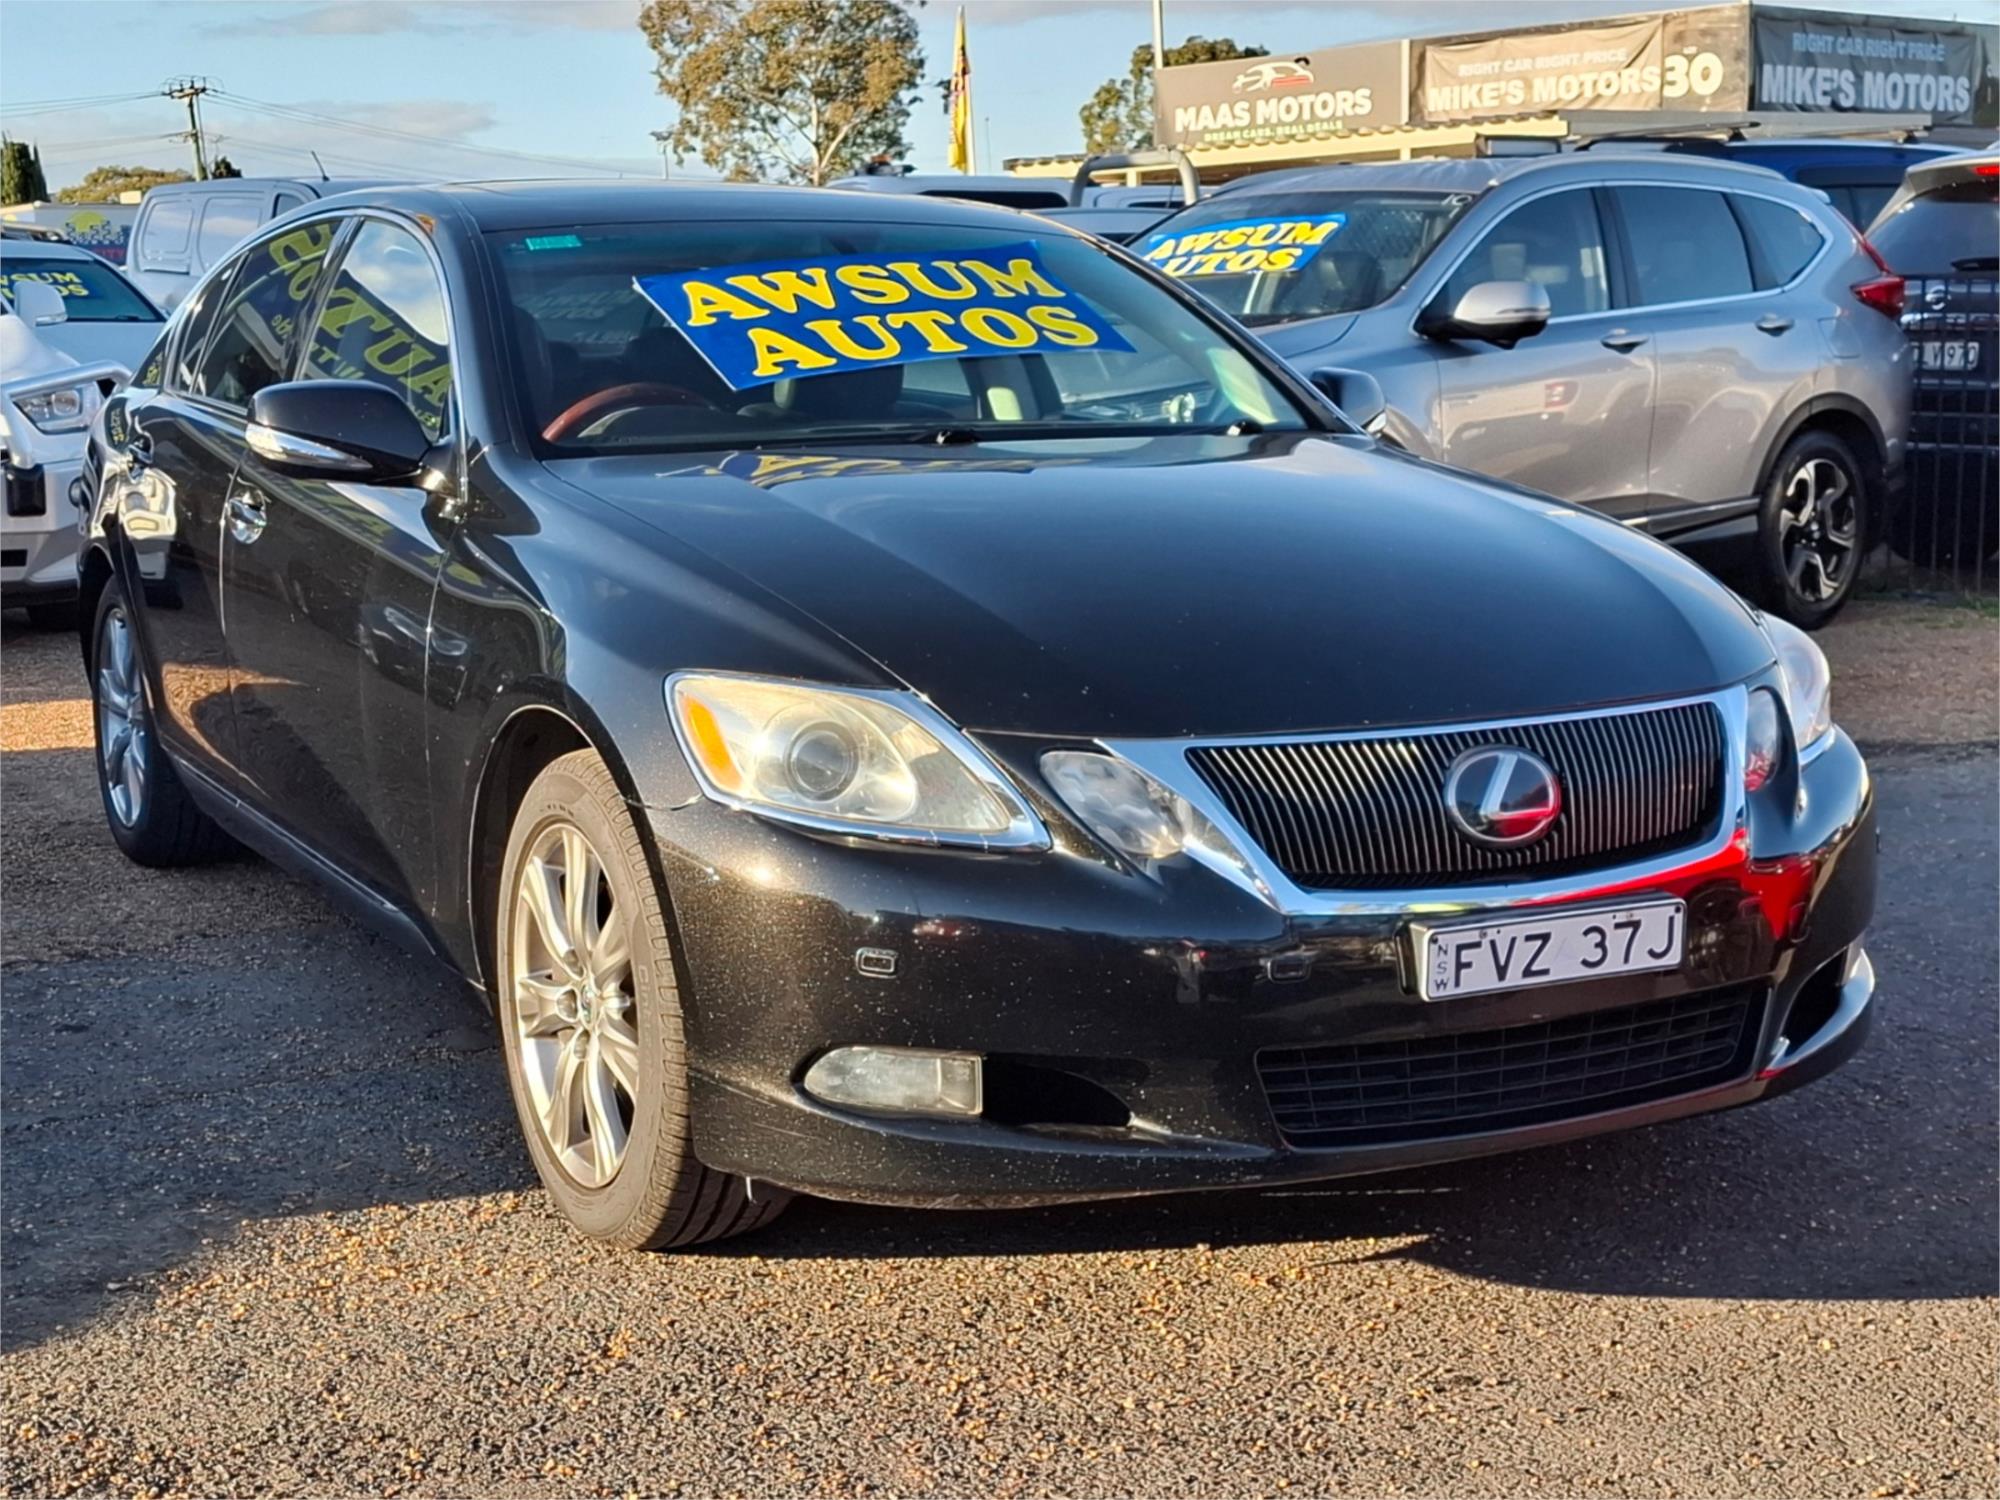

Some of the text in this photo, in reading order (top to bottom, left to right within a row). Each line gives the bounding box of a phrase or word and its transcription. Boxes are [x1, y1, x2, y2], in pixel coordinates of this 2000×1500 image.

[1458, 48, 1628, 77] RIGHT CAR RIGHT PRICE
[1792, 31, 1945, 62] RIGHT CAR RIGHT PRICE
[1427, 65, 1663, 112] MIKE'S MOTORS
[1662, 51, 1724, 98] 30
[1761, 63, 1970, 113] MIKE'S MOTORS
[1174, 88, 1373, 132] MAAS MOTORS
[1143, 221, 1339, 261] AWSUM
[1160, 247, 1303, 278] UTOS
[682, 259, 1067, 327] AWSUM
[747, 305, 1100, 377] AUTOS
[1453, 914, 1676, 989] FVZ 37J
